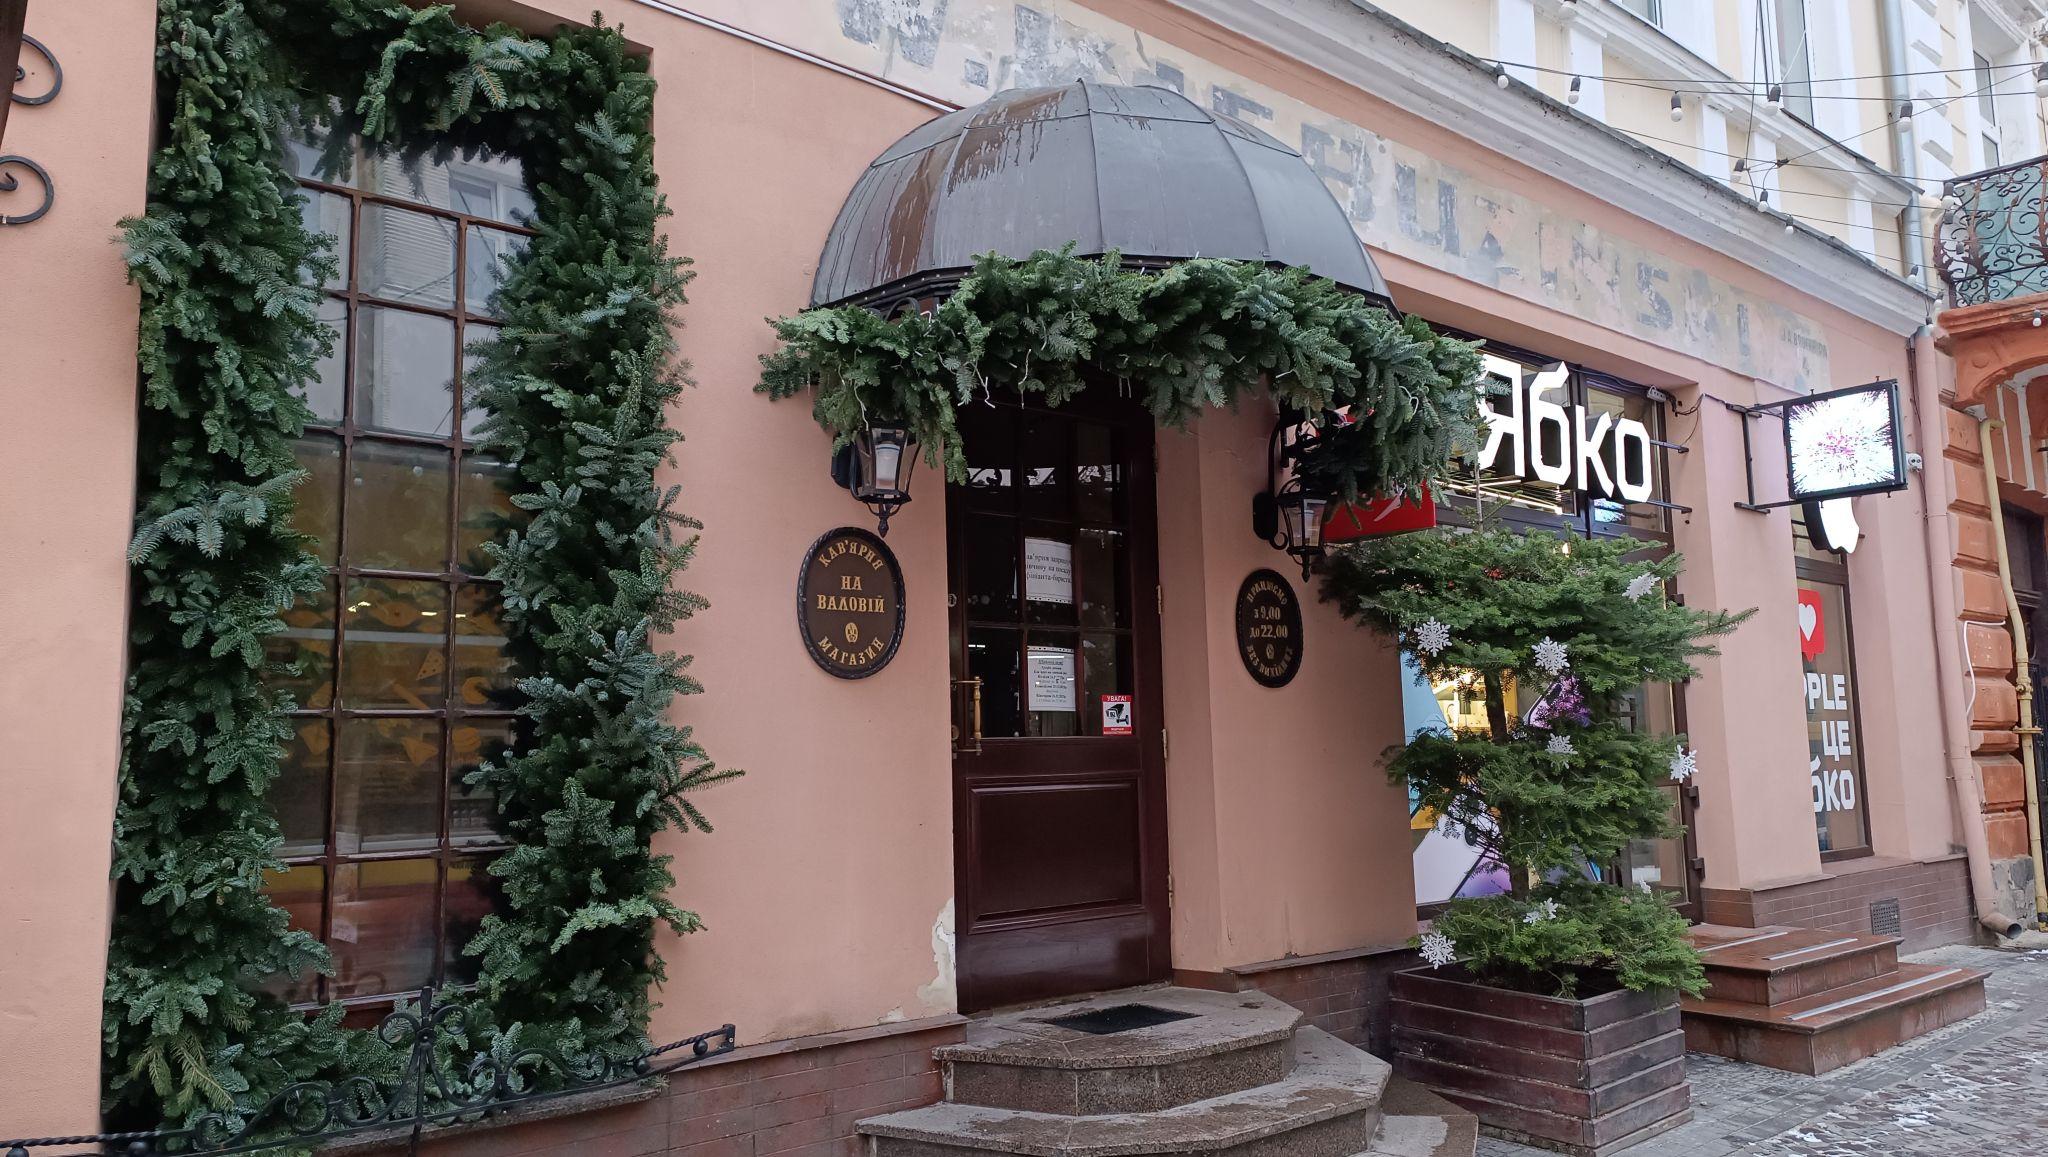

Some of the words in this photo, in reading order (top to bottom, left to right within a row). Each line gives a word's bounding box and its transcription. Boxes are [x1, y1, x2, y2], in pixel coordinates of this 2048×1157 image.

[818, 539, 884, 571] КАВ'ЯРНЯ
[841, 575, 862, 591] НА
[816, 594, 885, 614] ВАЛОВІЙ
[1260, 605, 1281, 621] 9.00
[1261, 624, 1288, 639] 22.00
[818, 635, 885, 666] МАГАЗИН
[1803, 672, 1848, 711] PLE
[1820, 720, 1852, 762] ЦЕ
